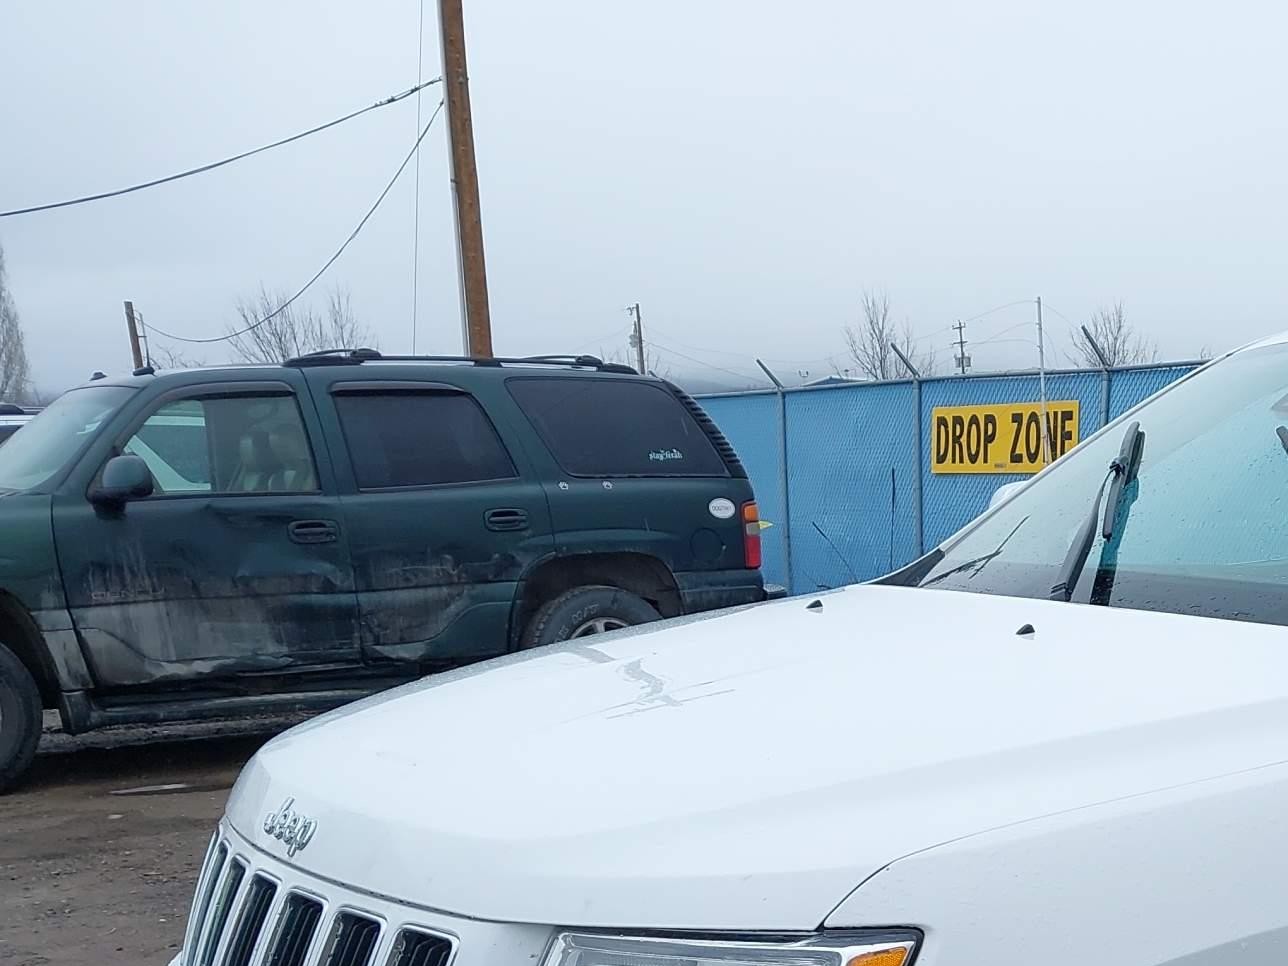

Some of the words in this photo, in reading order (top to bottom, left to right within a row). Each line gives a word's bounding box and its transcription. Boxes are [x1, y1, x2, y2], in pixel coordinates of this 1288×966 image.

[935, 413, 998, 465] DROP
[1009, 410, 1074, 464] ZONE
[263, 796, 318, 858] Jeep
